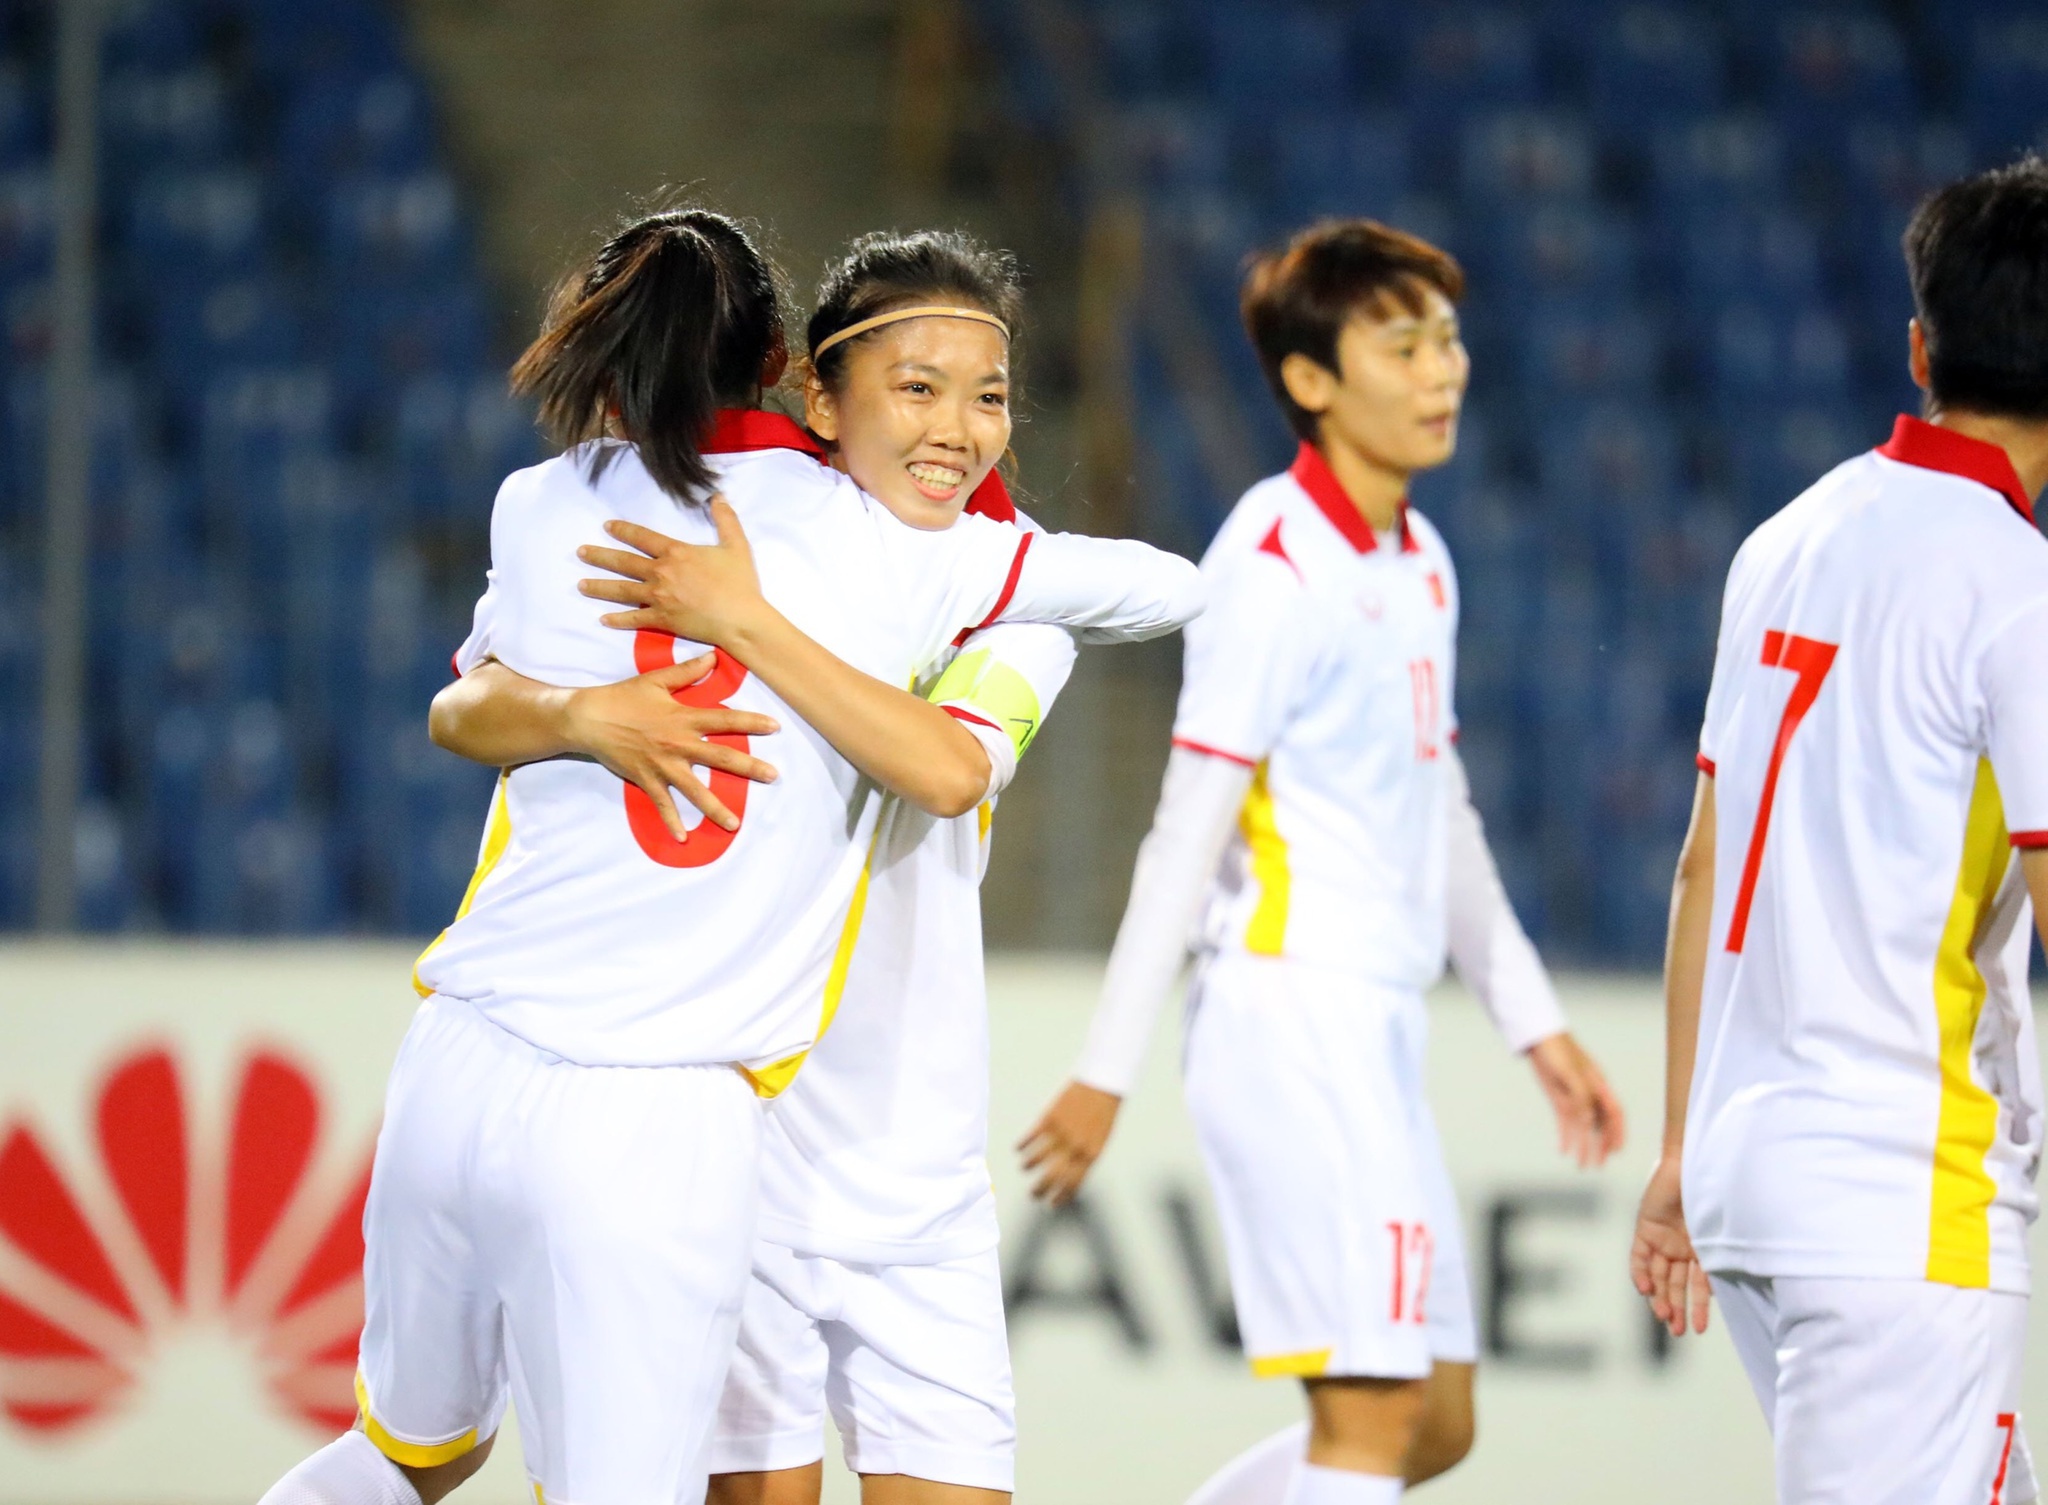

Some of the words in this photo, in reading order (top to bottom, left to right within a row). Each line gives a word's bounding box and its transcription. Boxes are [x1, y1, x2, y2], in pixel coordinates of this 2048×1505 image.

[623, 602, 751, 868] 8
[1725, 629, 1840, 954] 7
[1384, 1220, 1434, 1325] 12
